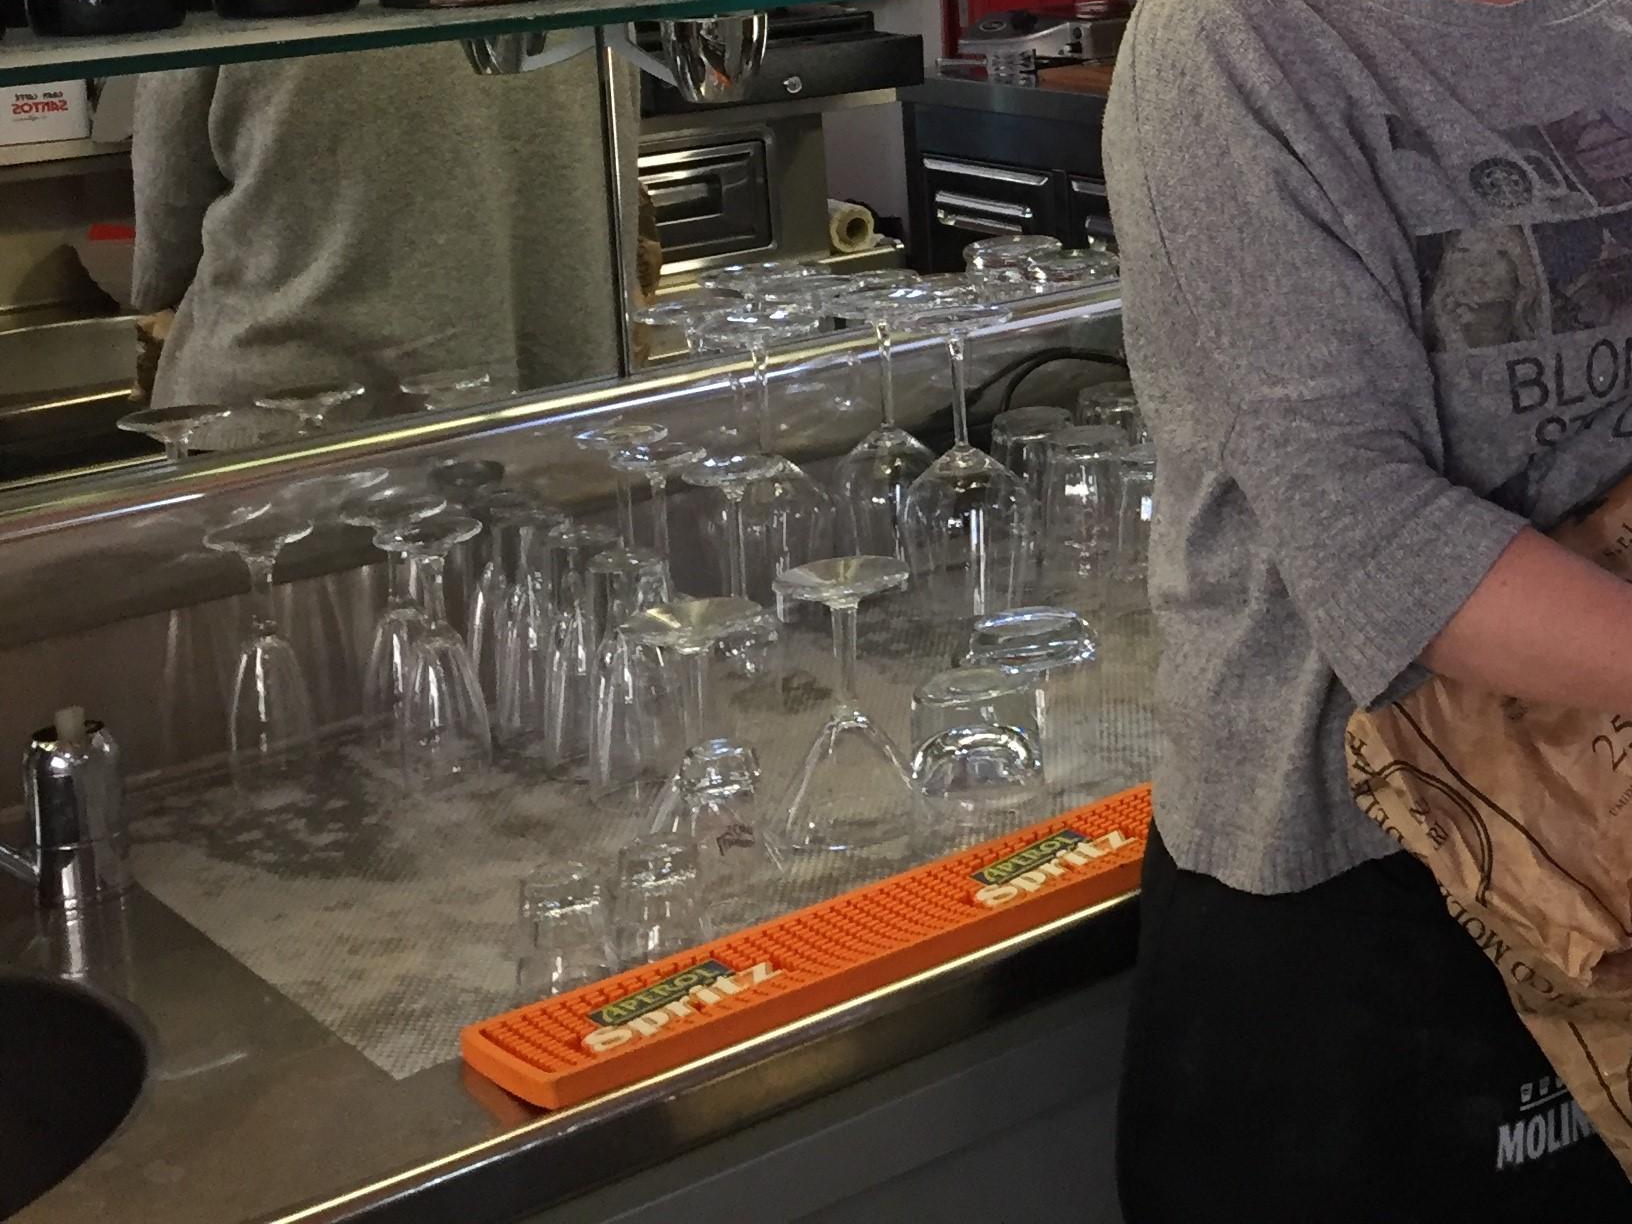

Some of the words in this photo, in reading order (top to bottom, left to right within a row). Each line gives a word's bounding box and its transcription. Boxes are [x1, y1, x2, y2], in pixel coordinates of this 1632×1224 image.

[975, 829, 1137, 907] Spritz
[983, 836, 1077, 883] APEROL
[582, 961, 786, 1053] Spritz
[602, 968, 720, 1023] APEROL
